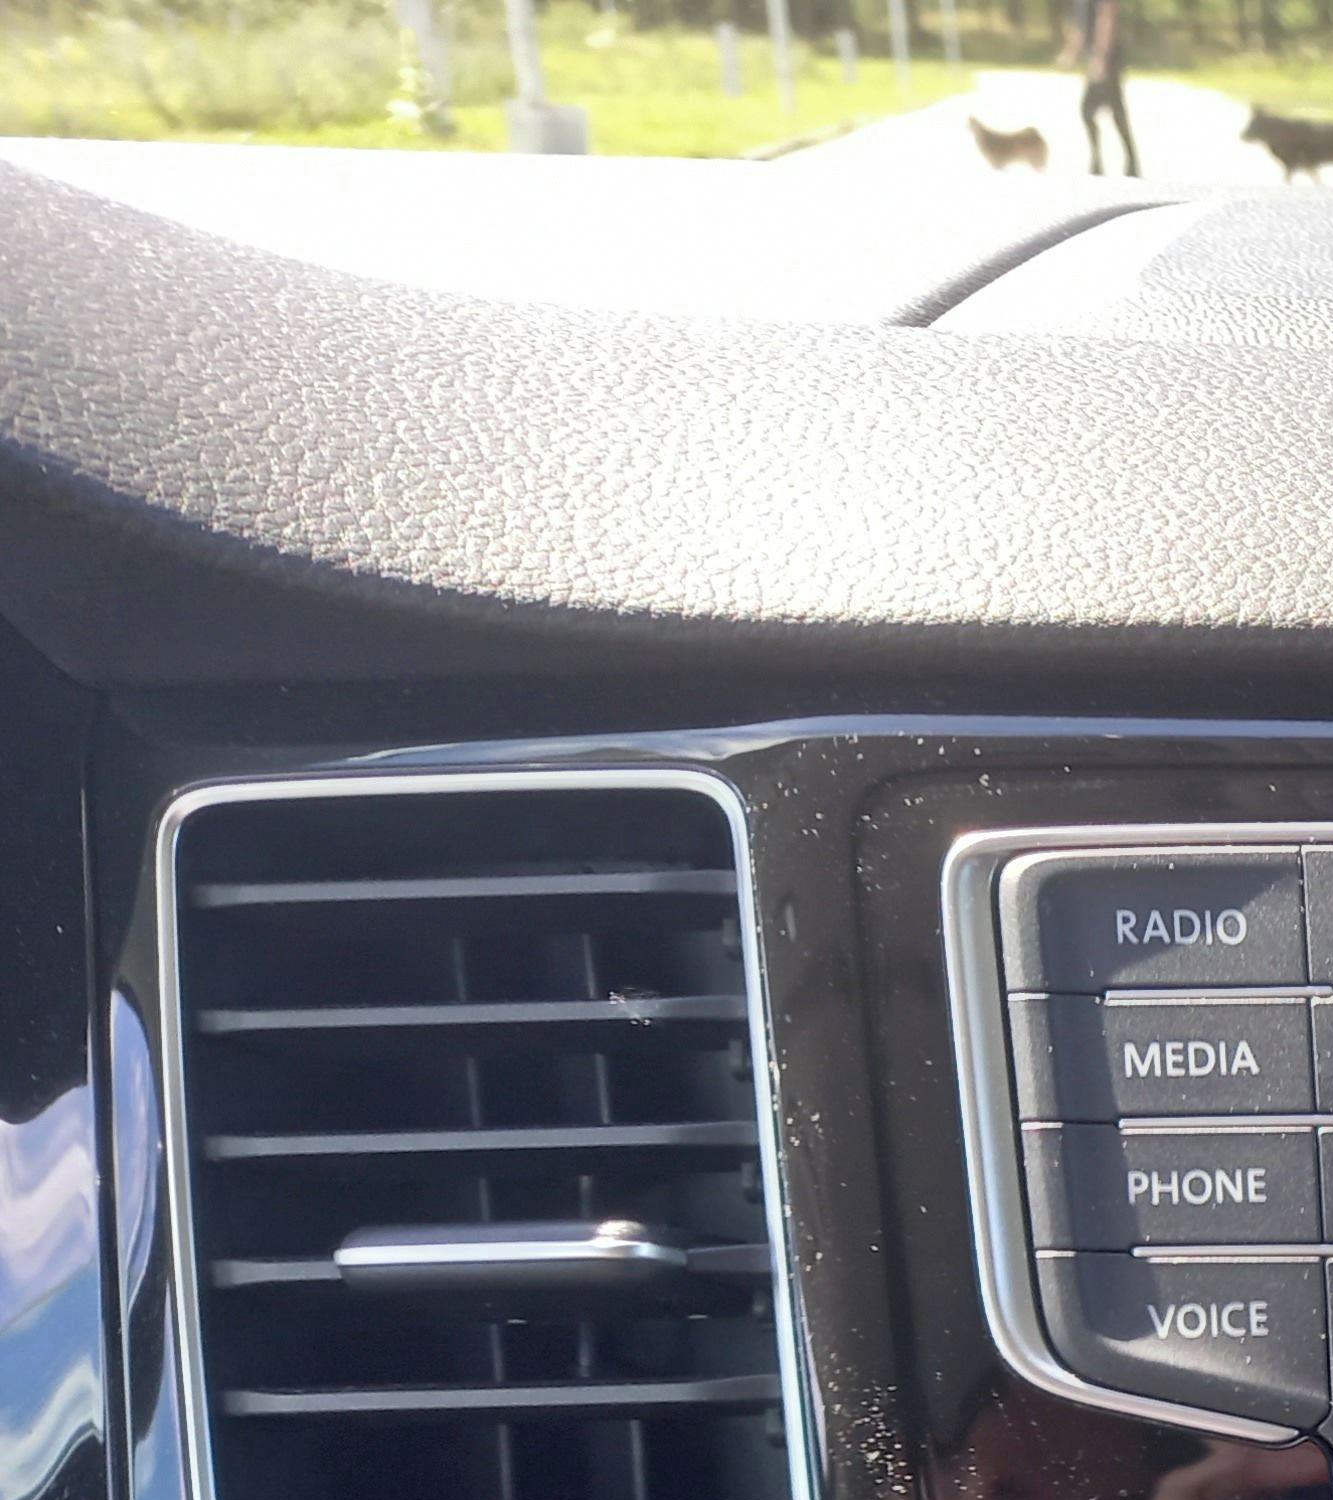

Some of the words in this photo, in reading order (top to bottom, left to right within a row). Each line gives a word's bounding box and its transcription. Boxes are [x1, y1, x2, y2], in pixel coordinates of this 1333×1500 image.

[1115, 909, 1248, 945] RADIO
[1123, 1041, 1260, 1078] MEDIA
[1127, 1168, 1268, 1205] PHONE
[1148, 1302, 1270, 1339] VOICE
